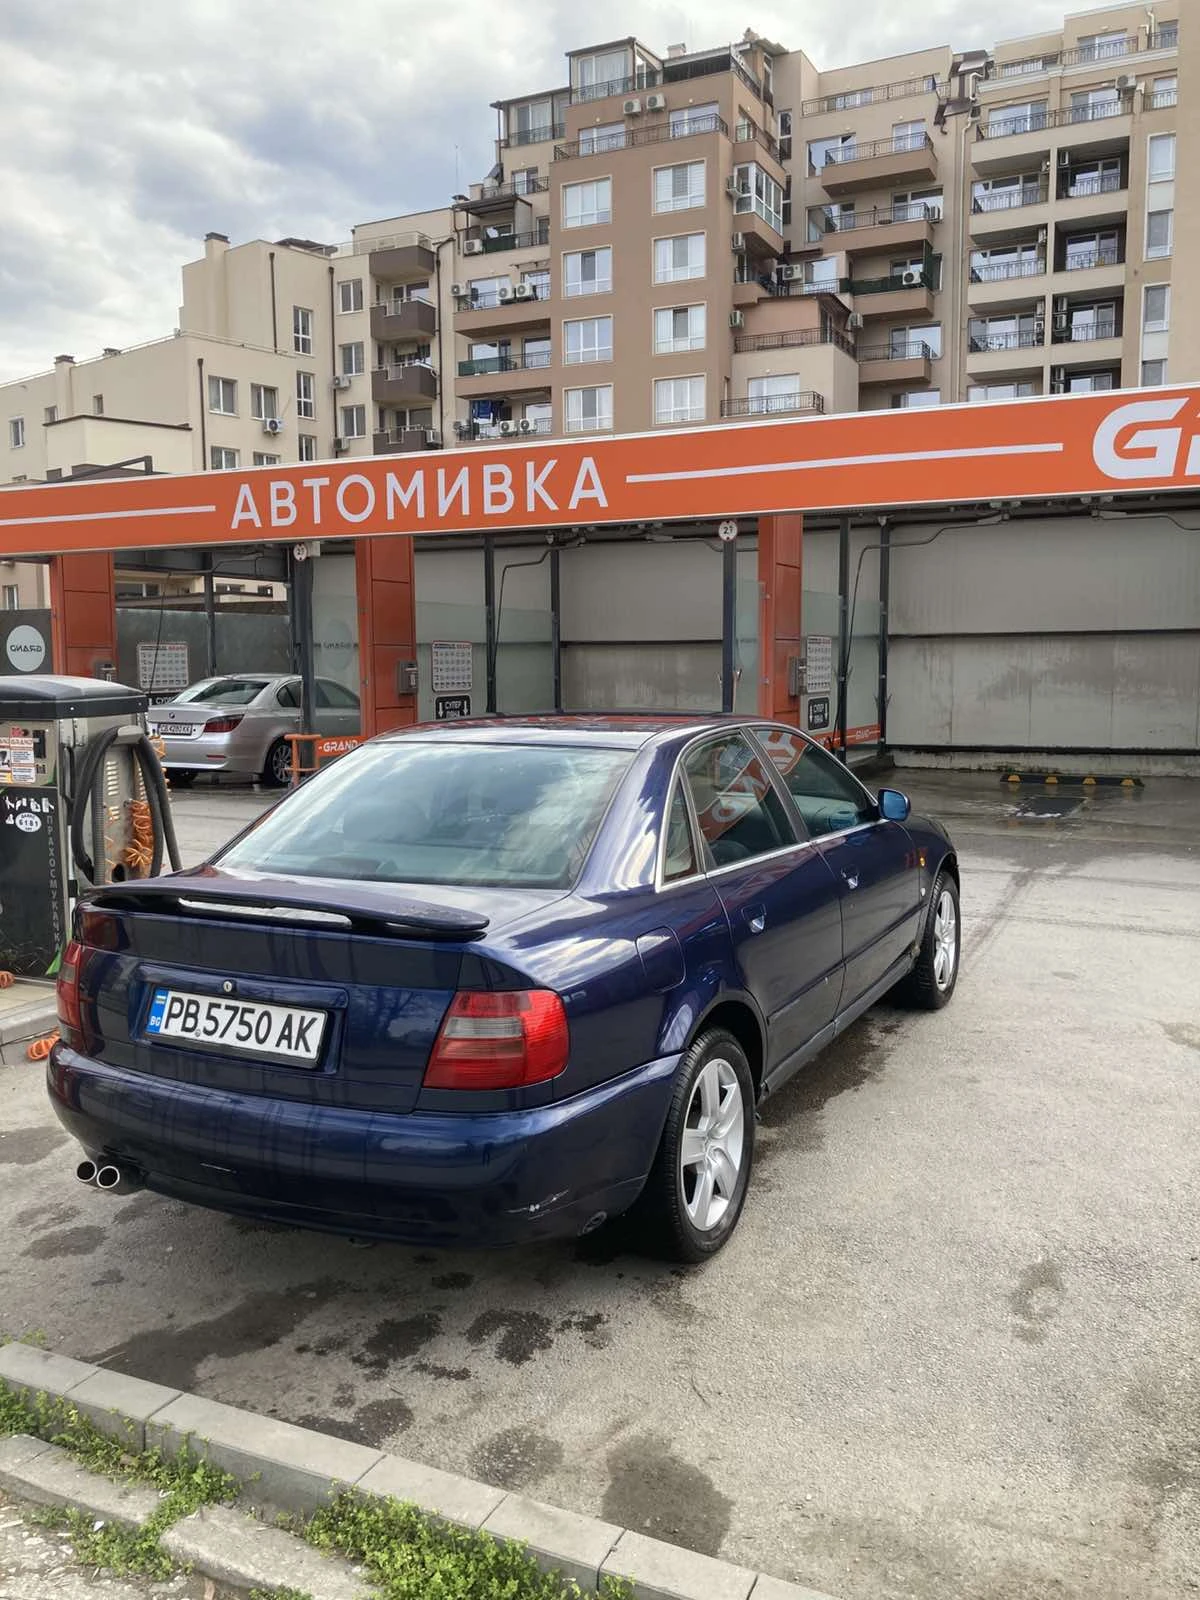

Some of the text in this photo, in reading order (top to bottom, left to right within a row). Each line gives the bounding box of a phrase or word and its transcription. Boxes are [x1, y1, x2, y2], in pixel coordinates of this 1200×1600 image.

[231, 456, 608, 529] АВТОМИВКА
[323, 739, 358, 753] GRAND
[149, 1016, 161, 1026] BG
[164, 996, 317, 1053] PB 5750 AK
